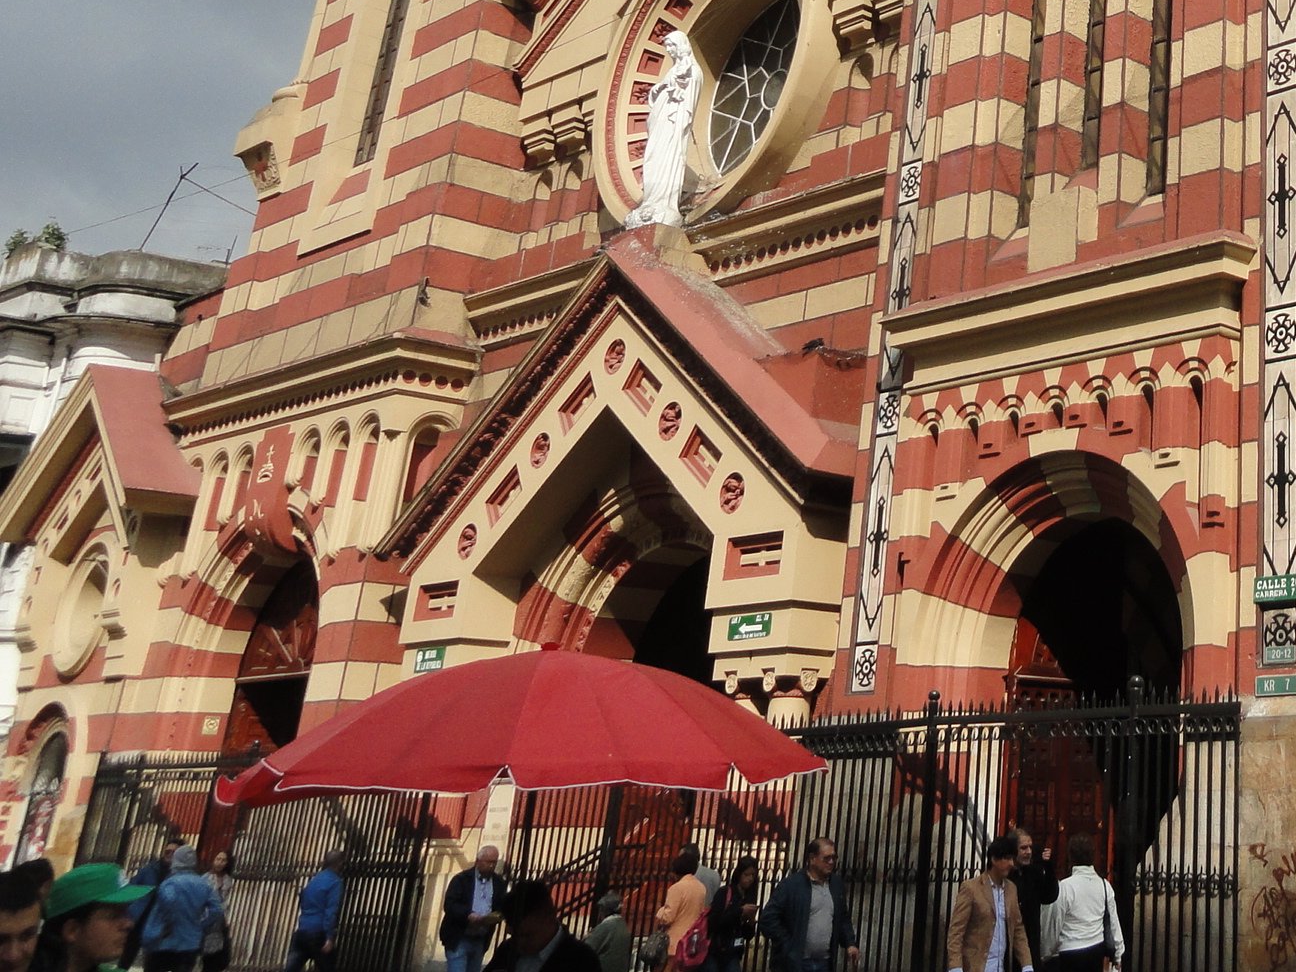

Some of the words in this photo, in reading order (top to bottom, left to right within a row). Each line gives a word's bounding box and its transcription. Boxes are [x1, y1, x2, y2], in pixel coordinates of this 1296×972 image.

[1256, 578, 1286, 590] CALLE
[1255, 589, 1288, 598] CARRERA
[1271, 648, 1292, 659] 20-12
[1264, 679, 1275, 692] KR
[1285, 678, 1291, 691] 7
